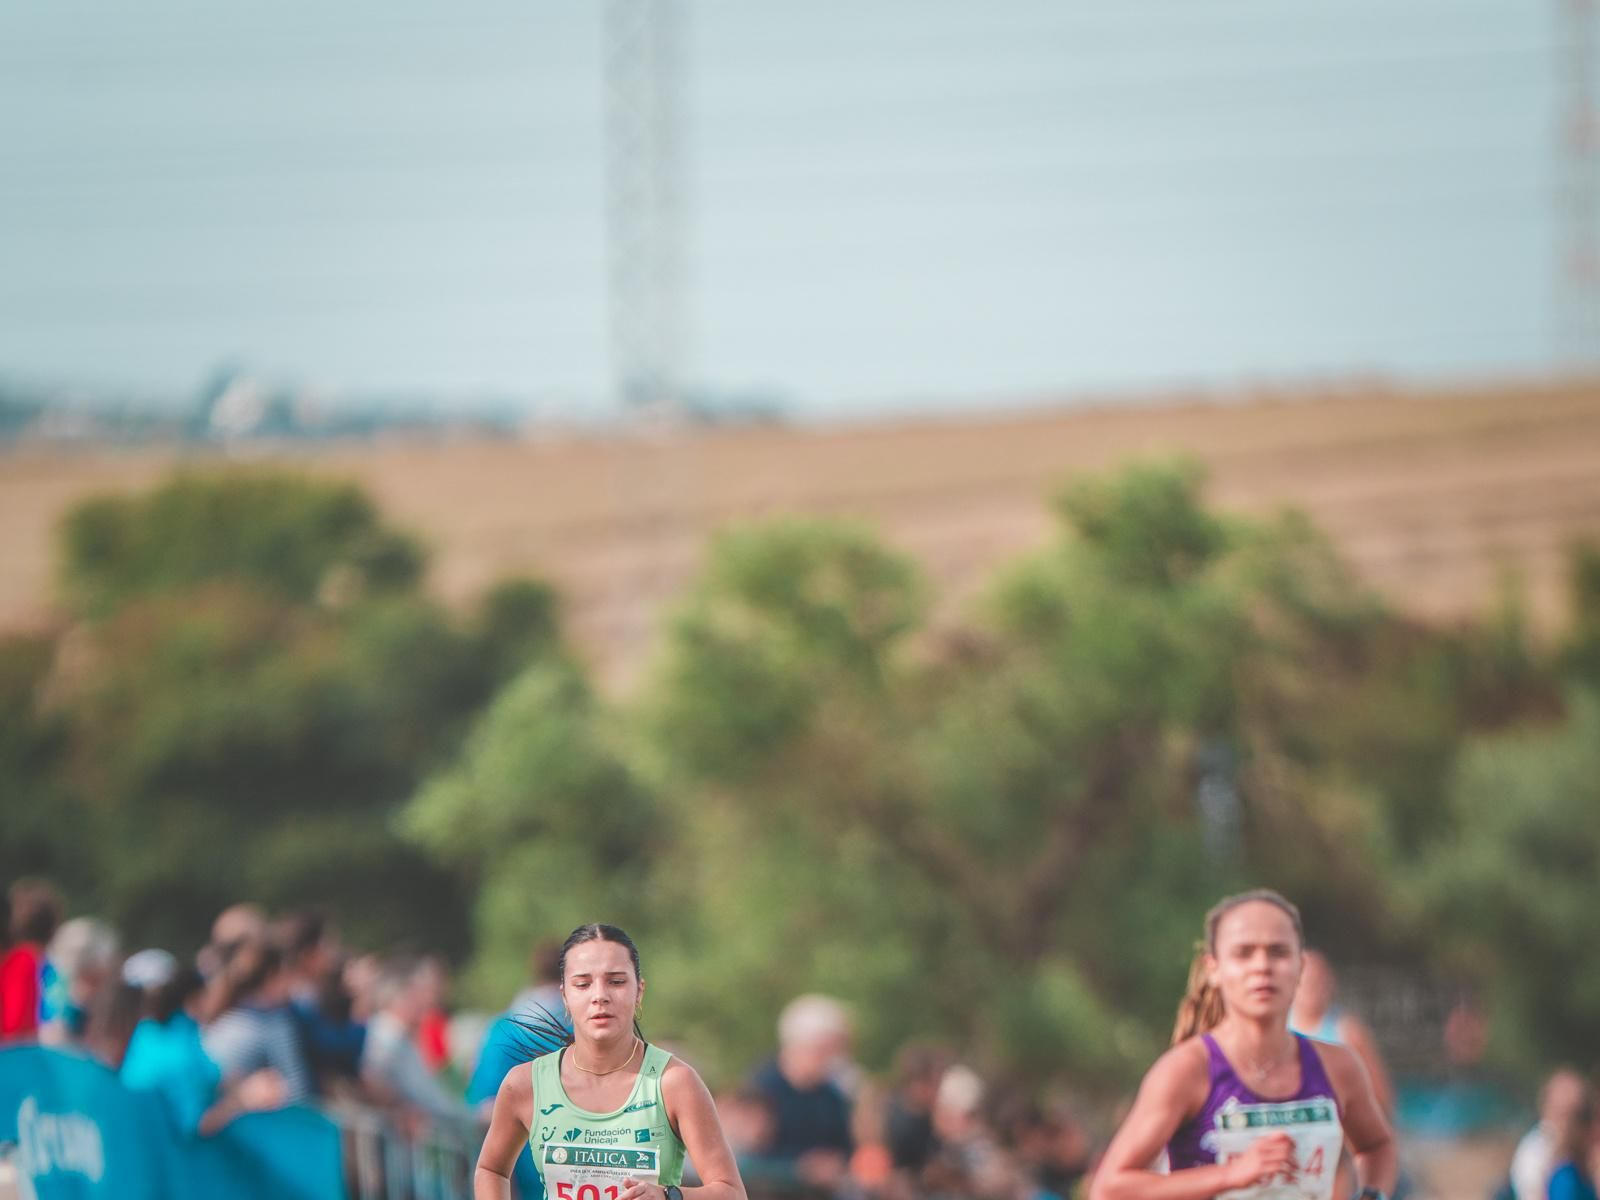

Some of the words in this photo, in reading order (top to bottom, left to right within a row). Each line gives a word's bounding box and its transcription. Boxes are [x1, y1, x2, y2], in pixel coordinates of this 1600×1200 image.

[584, 1127, 631, 1137] Fundación
[584, 1136, 619, 1145] Unicaja
[575, 1149, 628, 1165] ITÁLICA
